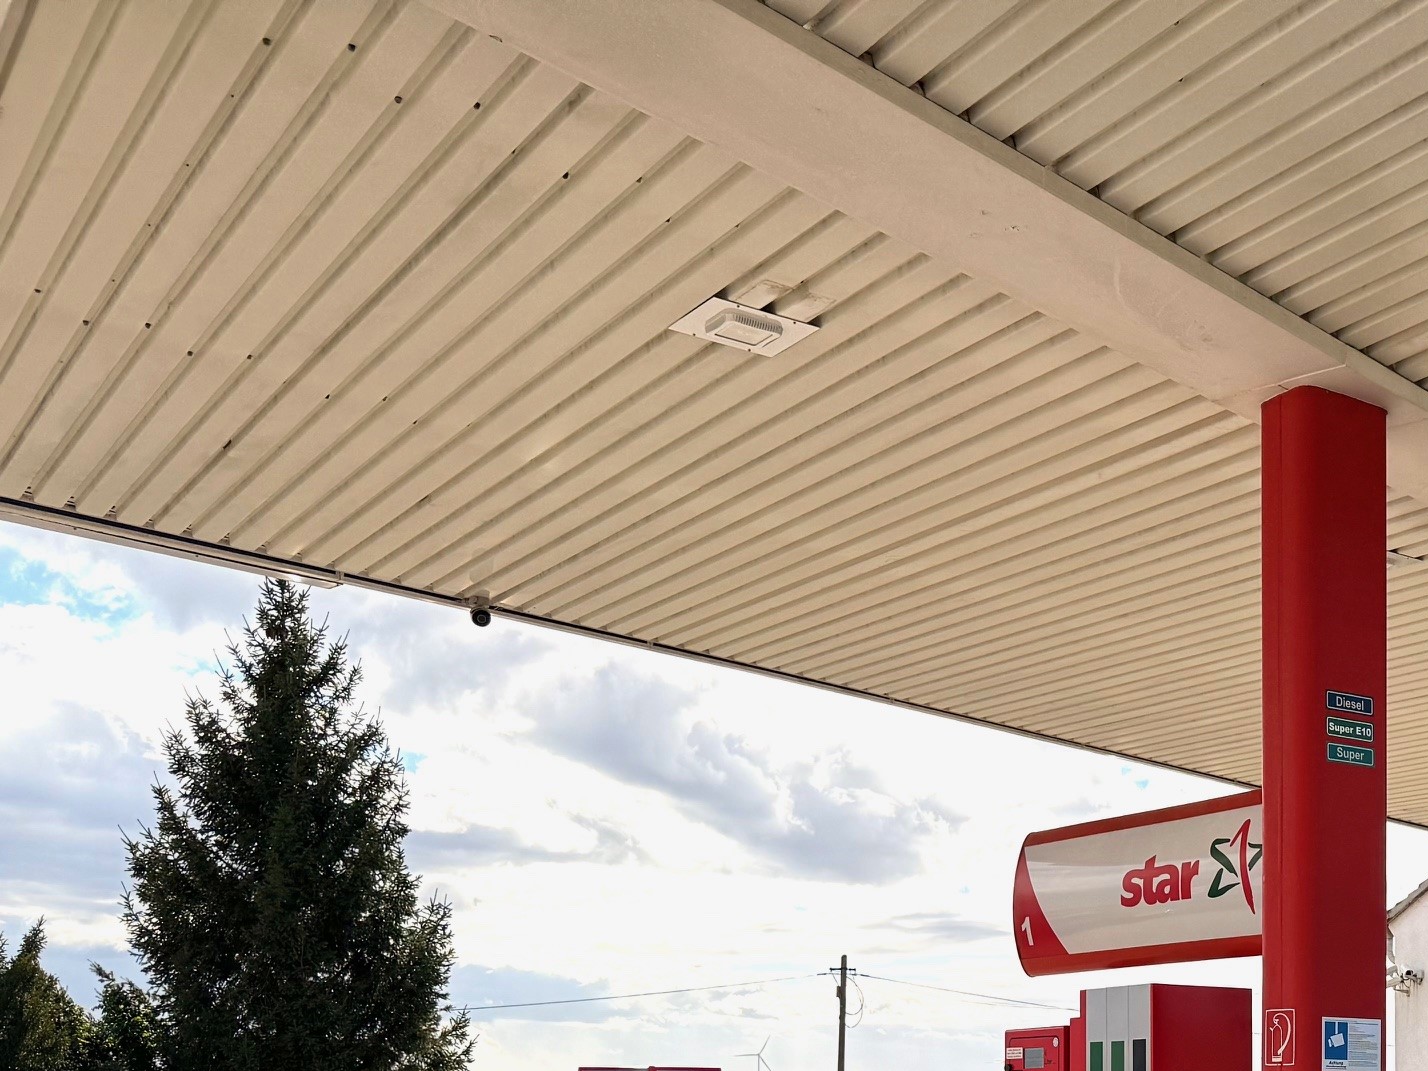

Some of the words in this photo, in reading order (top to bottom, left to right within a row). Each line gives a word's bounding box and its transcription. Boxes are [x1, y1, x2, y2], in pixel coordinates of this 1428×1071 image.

[1336, 696, 1364, 711] Diesel
[1328, 722, 1354, 735] Super
[1355, 723, 1372, 737] E10
[1336, 747, 1365, 762] Super
[1120, 854, 1200, 907] star
[1021, 916, 1034, 946] 1
